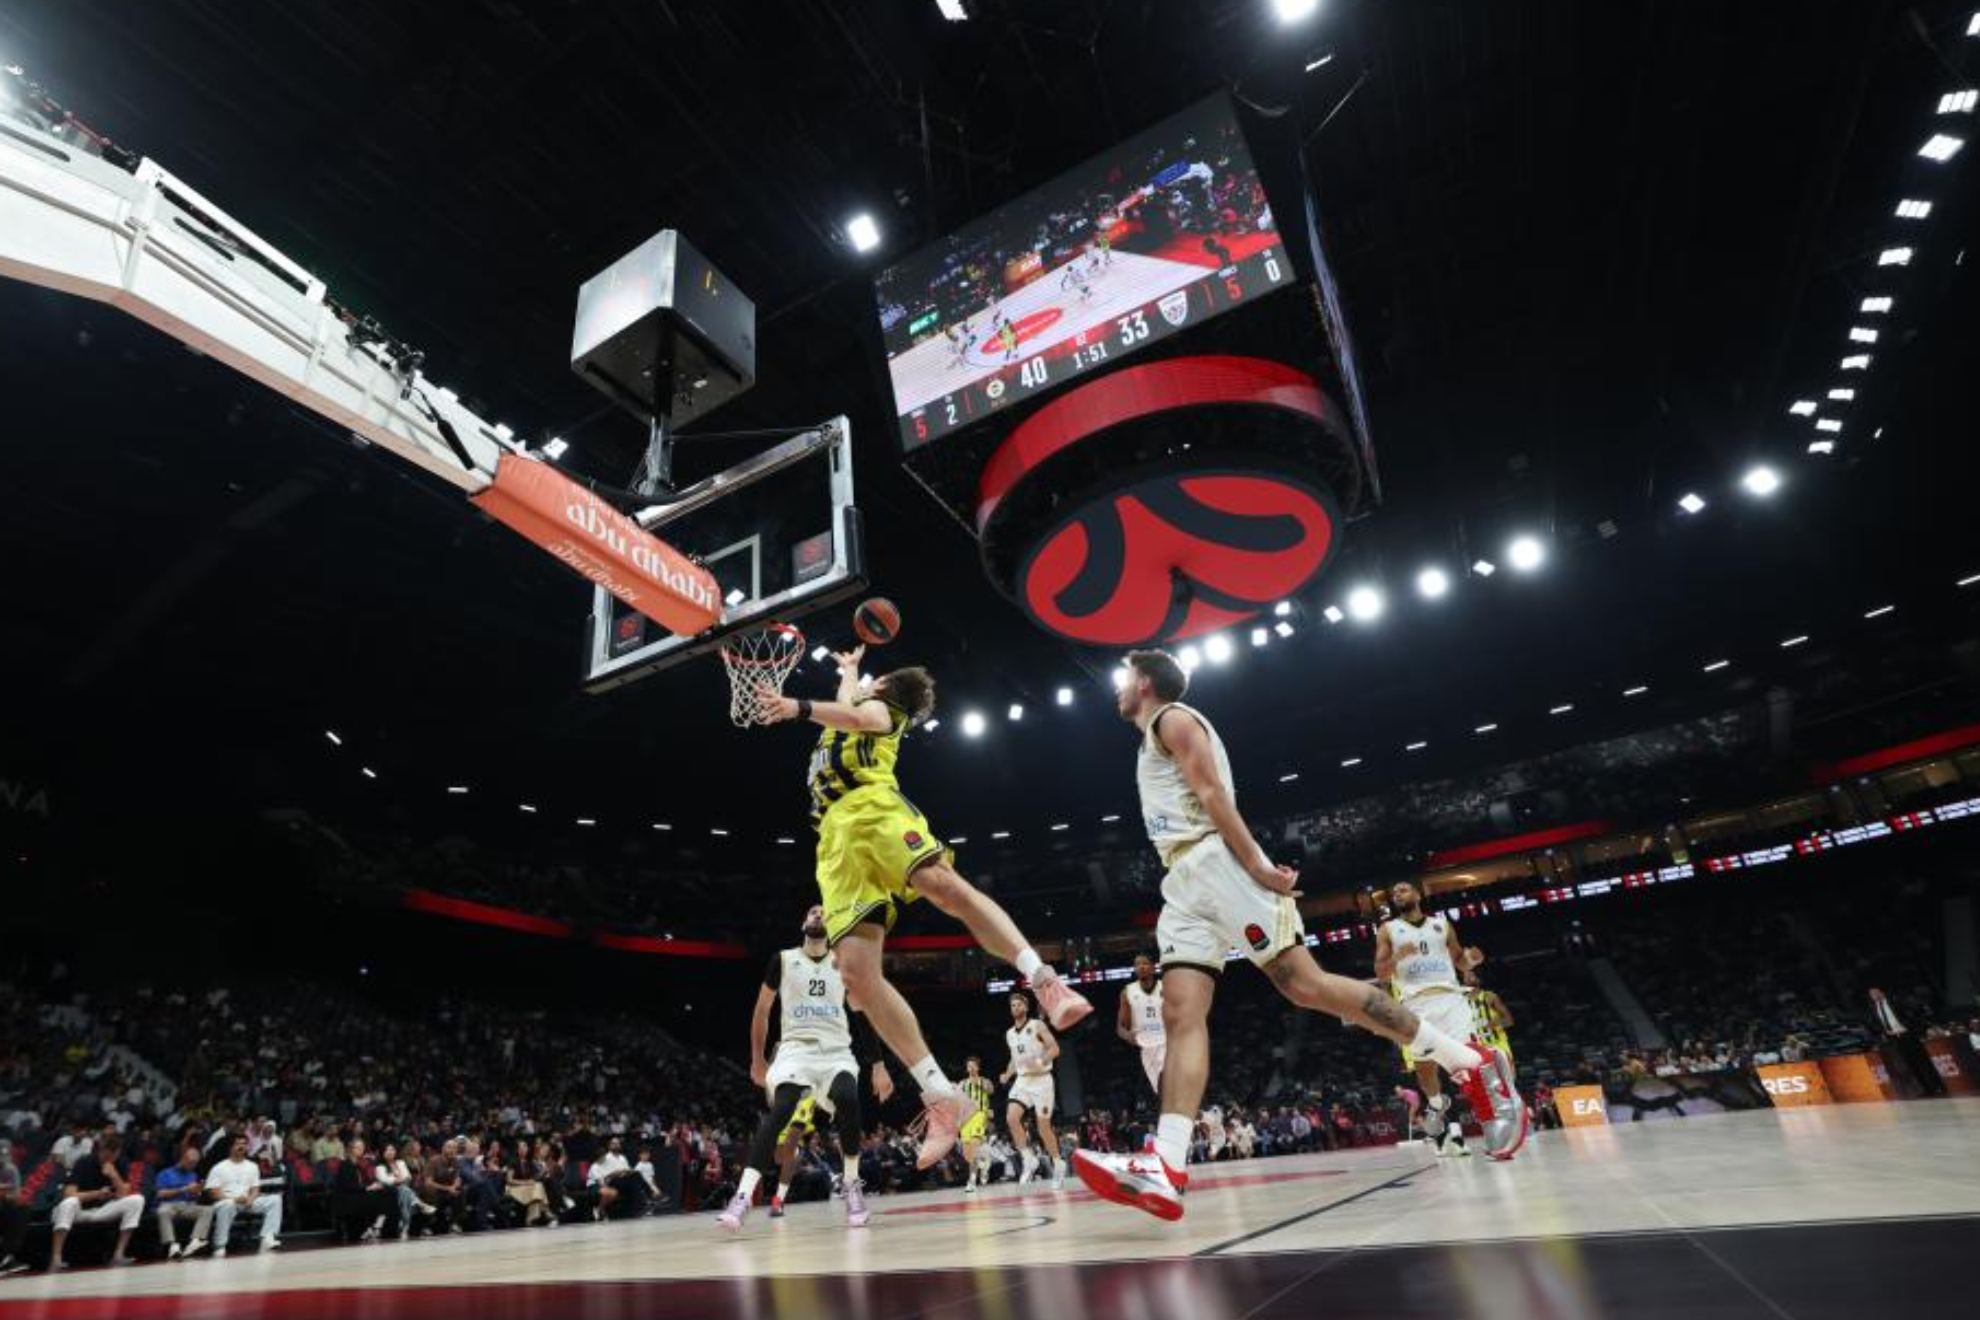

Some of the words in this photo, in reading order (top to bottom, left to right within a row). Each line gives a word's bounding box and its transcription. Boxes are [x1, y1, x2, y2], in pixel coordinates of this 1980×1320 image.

[1264, 259, 1281, 282] 0
[1225, 277, 1242, 300] 5
[1118, 310, 1149, 345] 33
[1074, 341, 1108, 370] 1:51
[1021, 355, 1047, 388] 40
[946, 403, 959, 425] 2
[914, 417, 927, 440] 5
[566, 502, 625, 555] abu
[632, 545, 713, 612] dhabi
[808, 979, 826, 996] 23
[794, 1002, 839, 1018] dnata
